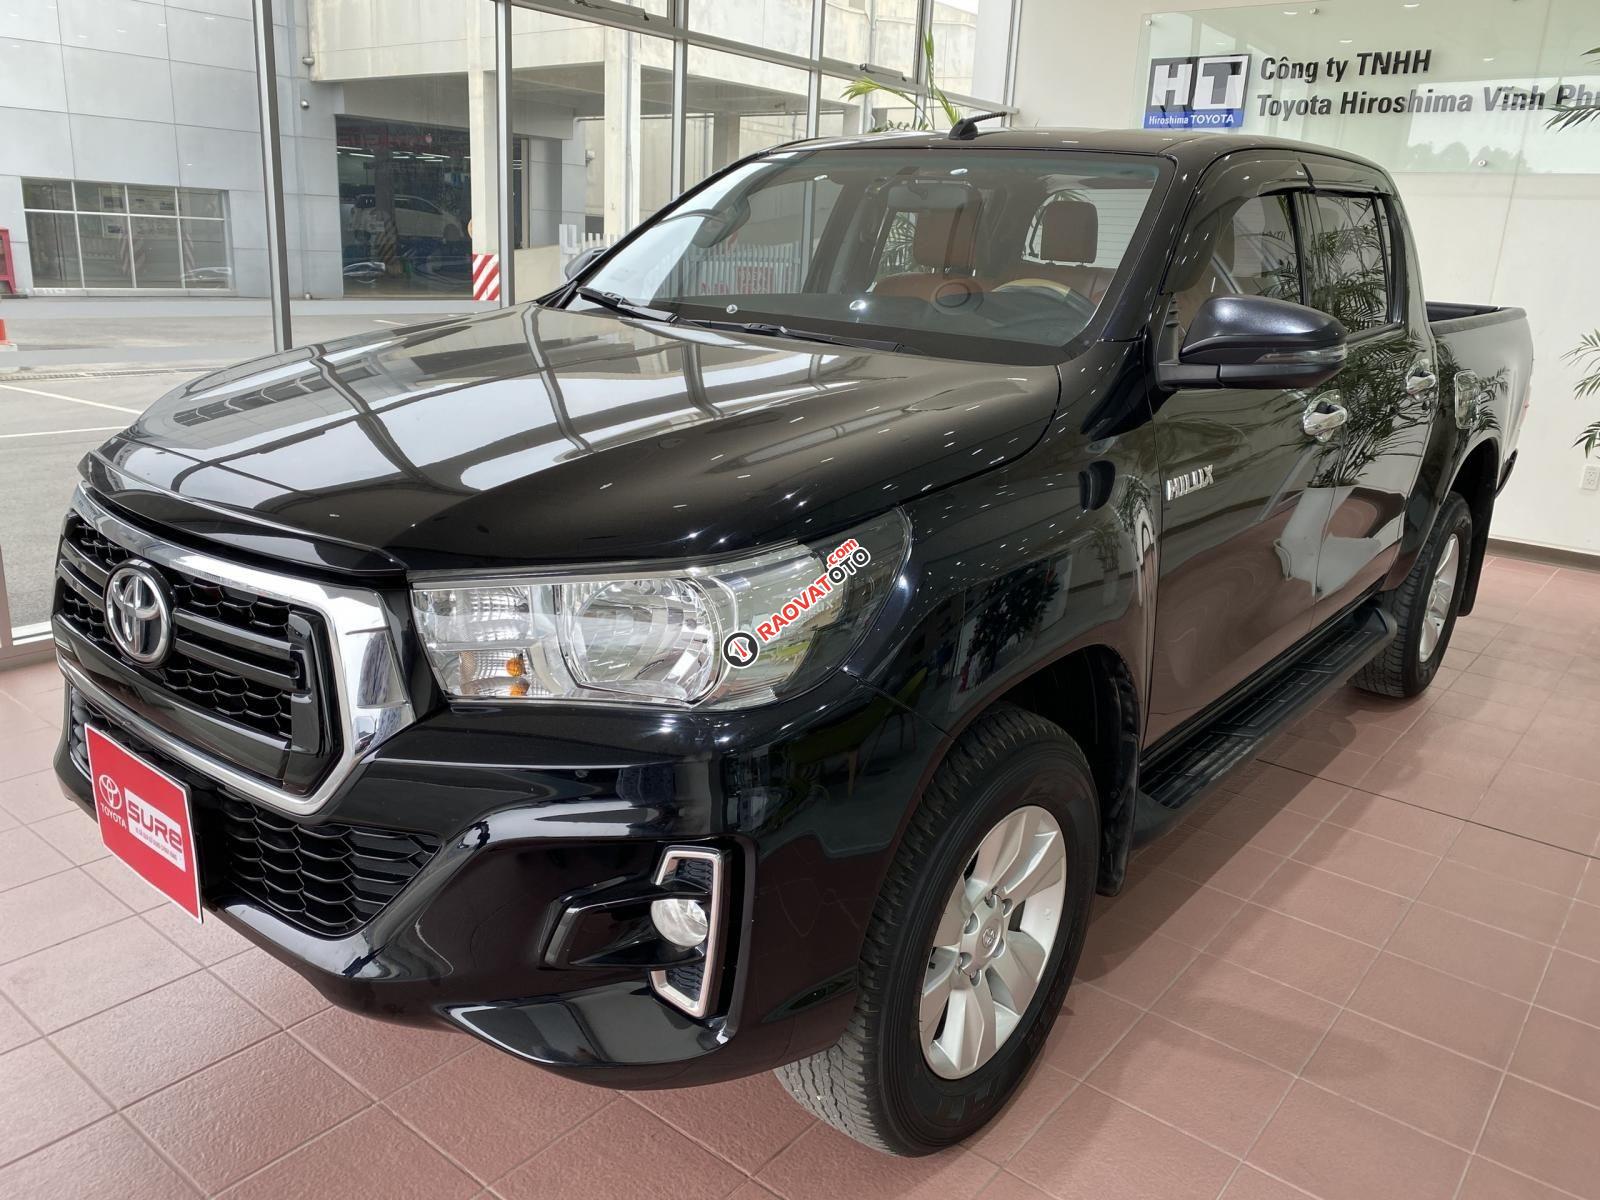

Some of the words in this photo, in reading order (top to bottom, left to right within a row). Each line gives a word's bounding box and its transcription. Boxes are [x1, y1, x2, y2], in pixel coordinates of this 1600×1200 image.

[1260, 56, 1319, 84] Công
[1326, 57, 1349, 82] ty
[1357, 49, 1432, 76] TNHH
[1149, 115, 1189, 125] Hiroshima
[1190, 114, 1234, 124] TOYOTA
[1257, 95, 1332, 121] Toyota
[1340, 89, 1473, 115] Hiroshima
[1483, 85, 1546, 112] Vĩnh
[1166, 464, 1214, 501] HILUX
[100, 802, 127, 830] TOYOTA
[128, 800, 183, 854] SURE
